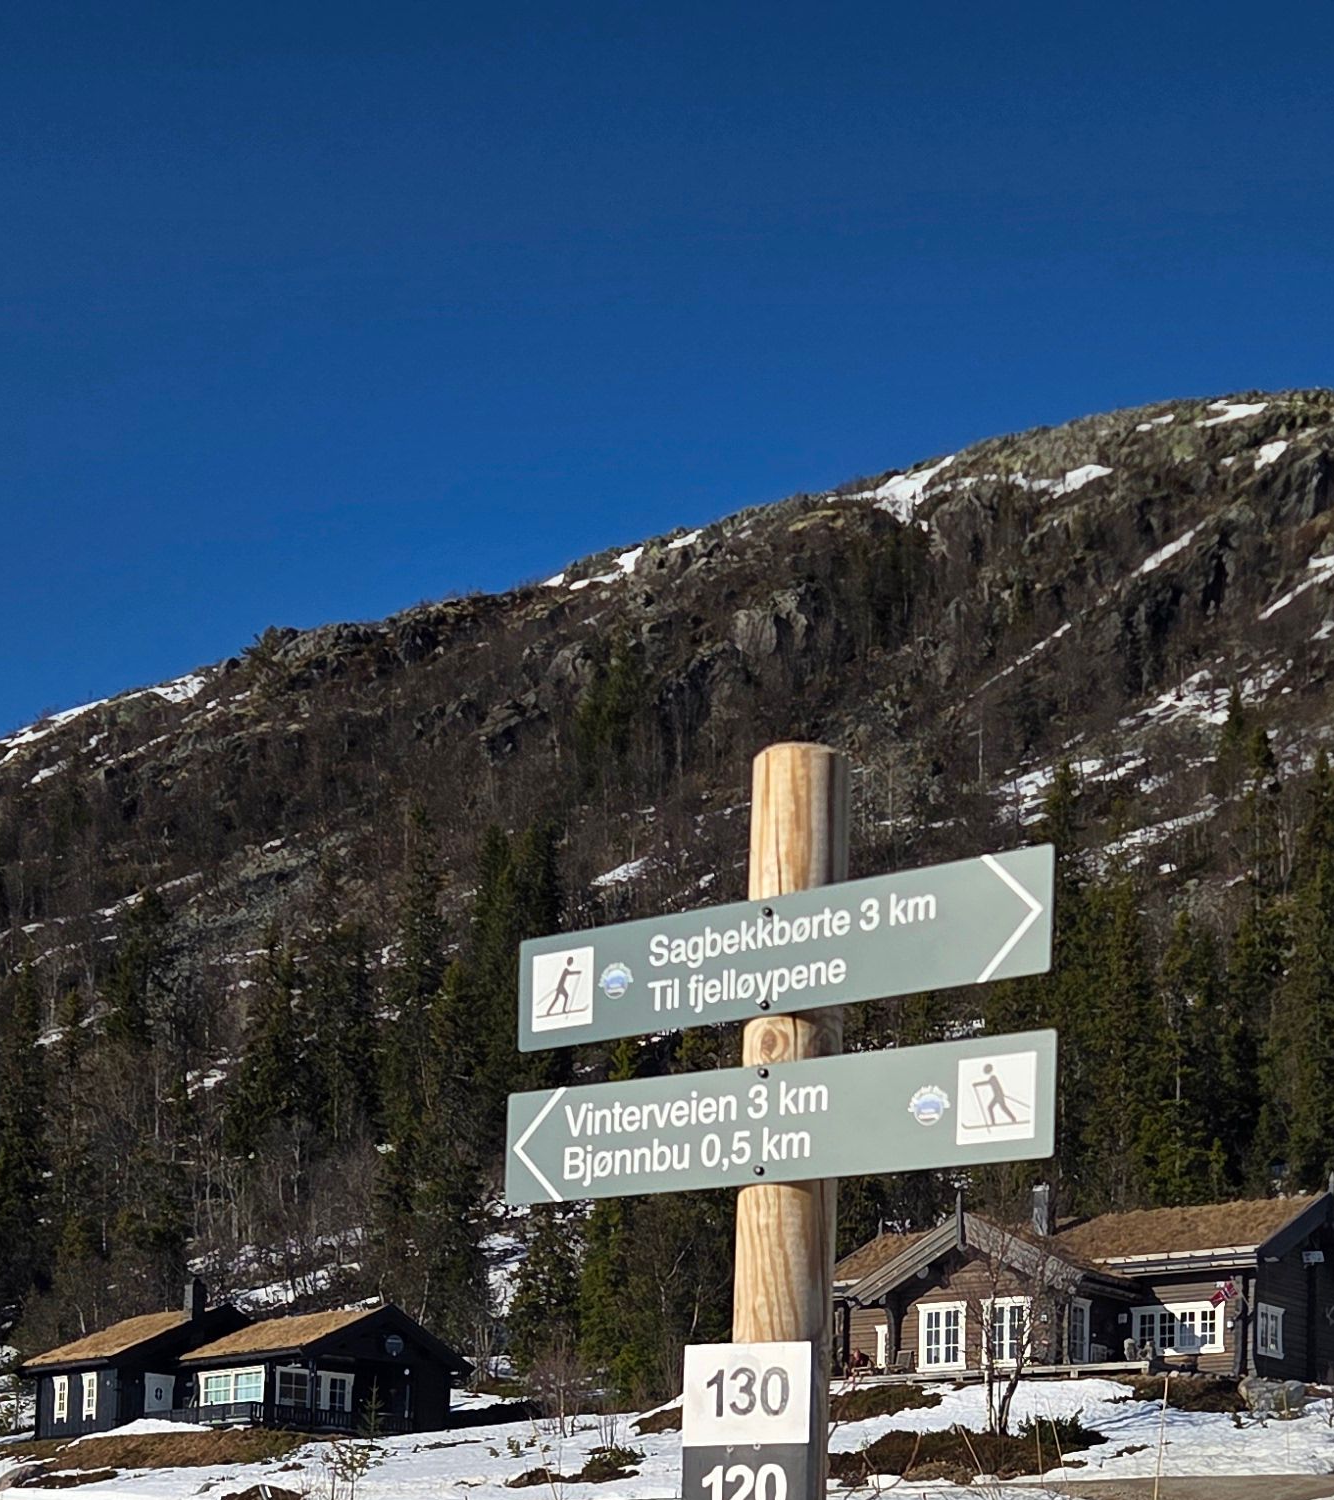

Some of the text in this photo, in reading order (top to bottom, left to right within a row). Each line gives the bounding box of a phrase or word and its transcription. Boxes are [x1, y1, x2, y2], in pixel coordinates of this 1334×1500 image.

[648, 893, 937, 968] Sagbekkbørte 3 km
[647, 977, 680, 1012] Til
[687, 957, 847, 1013] fjelløypene
[564, 1081, 829, 1138] Vinterveien 3 km
[563, 1127, 811, 1187] Bjønnbu 0,5 km
[705, 1366, 790, 1418] 130
